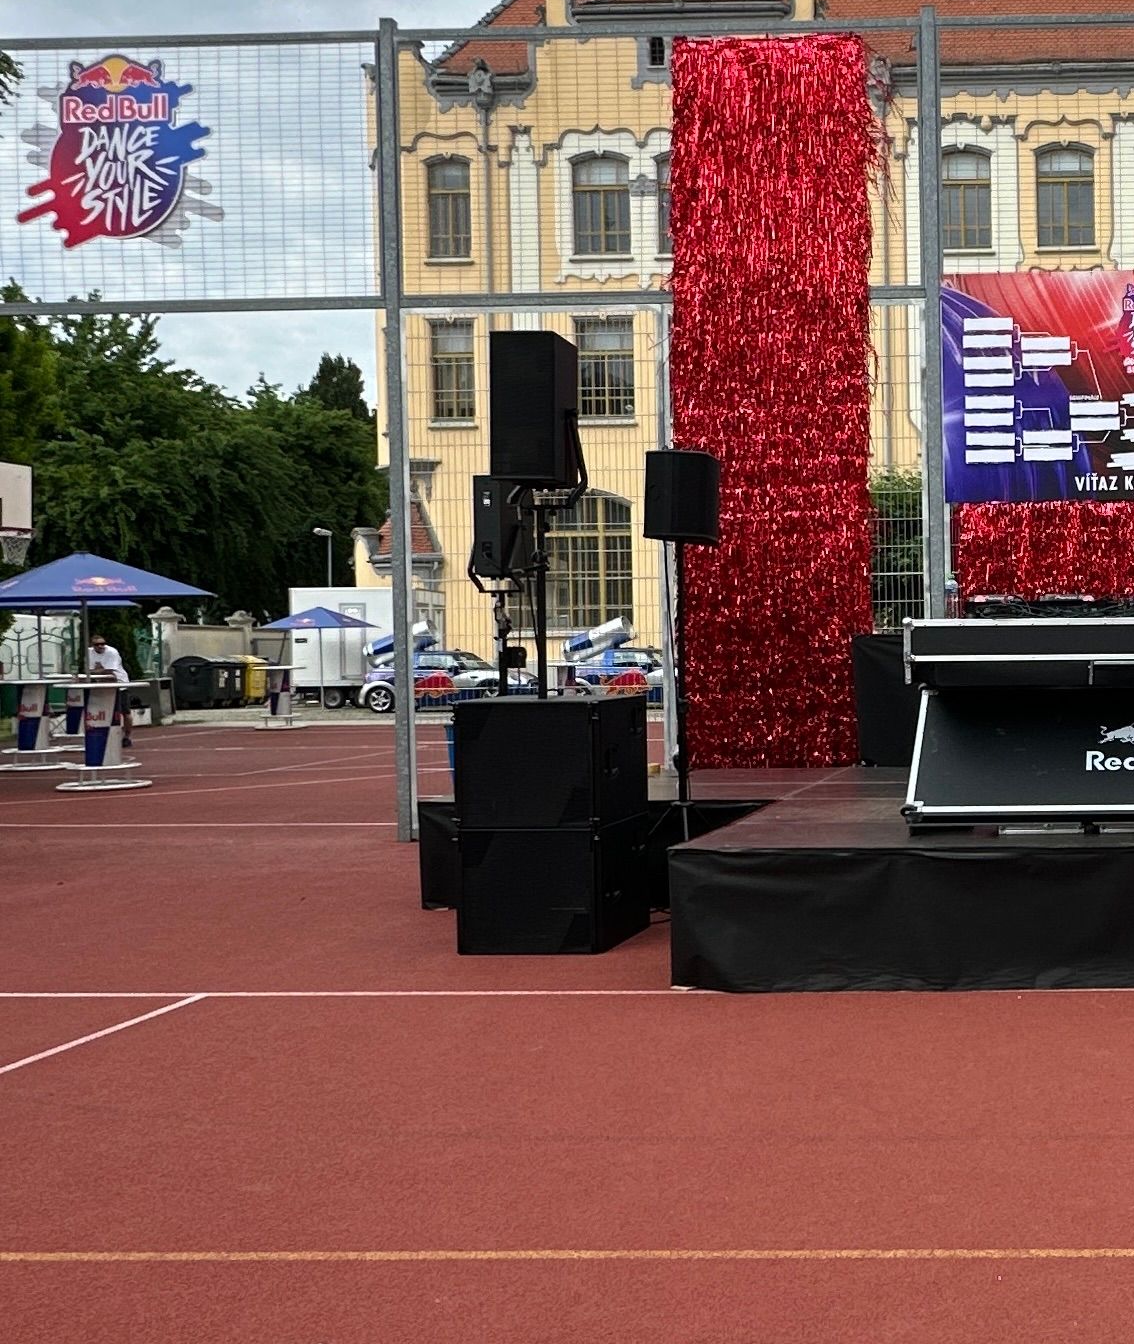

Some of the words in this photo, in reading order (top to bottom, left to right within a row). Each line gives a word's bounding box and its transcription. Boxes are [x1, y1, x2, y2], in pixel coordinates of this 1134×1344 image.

[63, 94, 116, 123] Red
[117, 93, 168, 122] Bull
[75, 123, 161, 165] DANCE
[84, 149, 169, 193] YOUR
[80, 174, 164, 232] STYLE
[1075, 472, 1118, 491] VÍŤAZ
